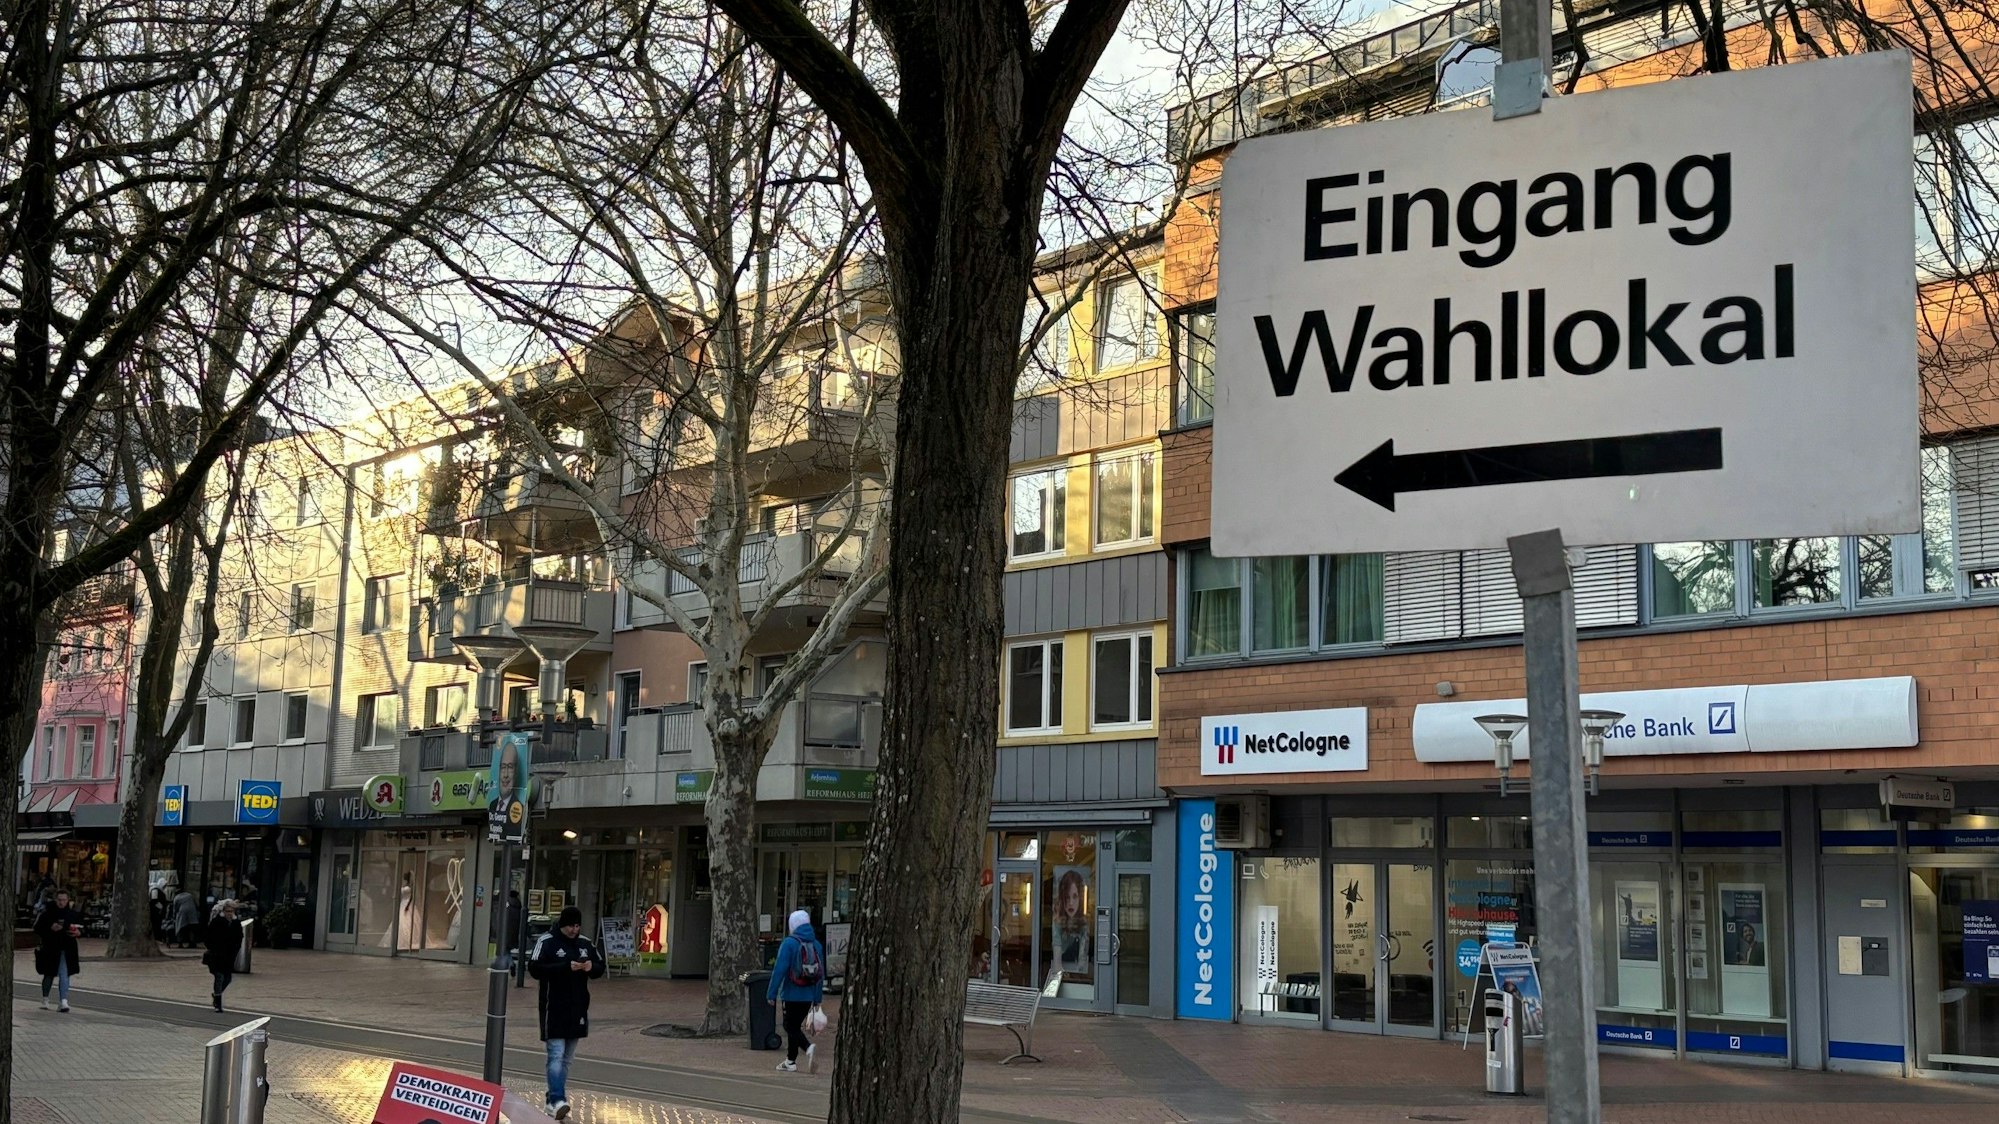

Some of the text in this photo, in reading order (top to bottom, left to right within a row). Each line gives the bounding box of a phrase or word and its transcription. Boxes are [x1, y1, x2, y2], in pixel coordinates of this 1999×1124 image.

[1303, 152, 1731, 268] Eingang
[1253, 263, 1796, 397] Wahllokal
[1644, 717, 1696, 737] Bank
[1245, 731, 1350, 756] NetCologne
[165, 798, 180, 812] TEDi
[242, 794, 278, 809] TEDi
[806, 789, 856, 799] REFORMHAUS
[1897, 790, 1940, 801] Deutsche Bank
[1194, 813, 1217, 1005] NetCologne
[1606, 1030, 1630, 1038] Deutsche
[399, 1074, 491, 1107] DEMOKRATIE
[395, 1088, 486, 1122] VERTEIDIGEN!
